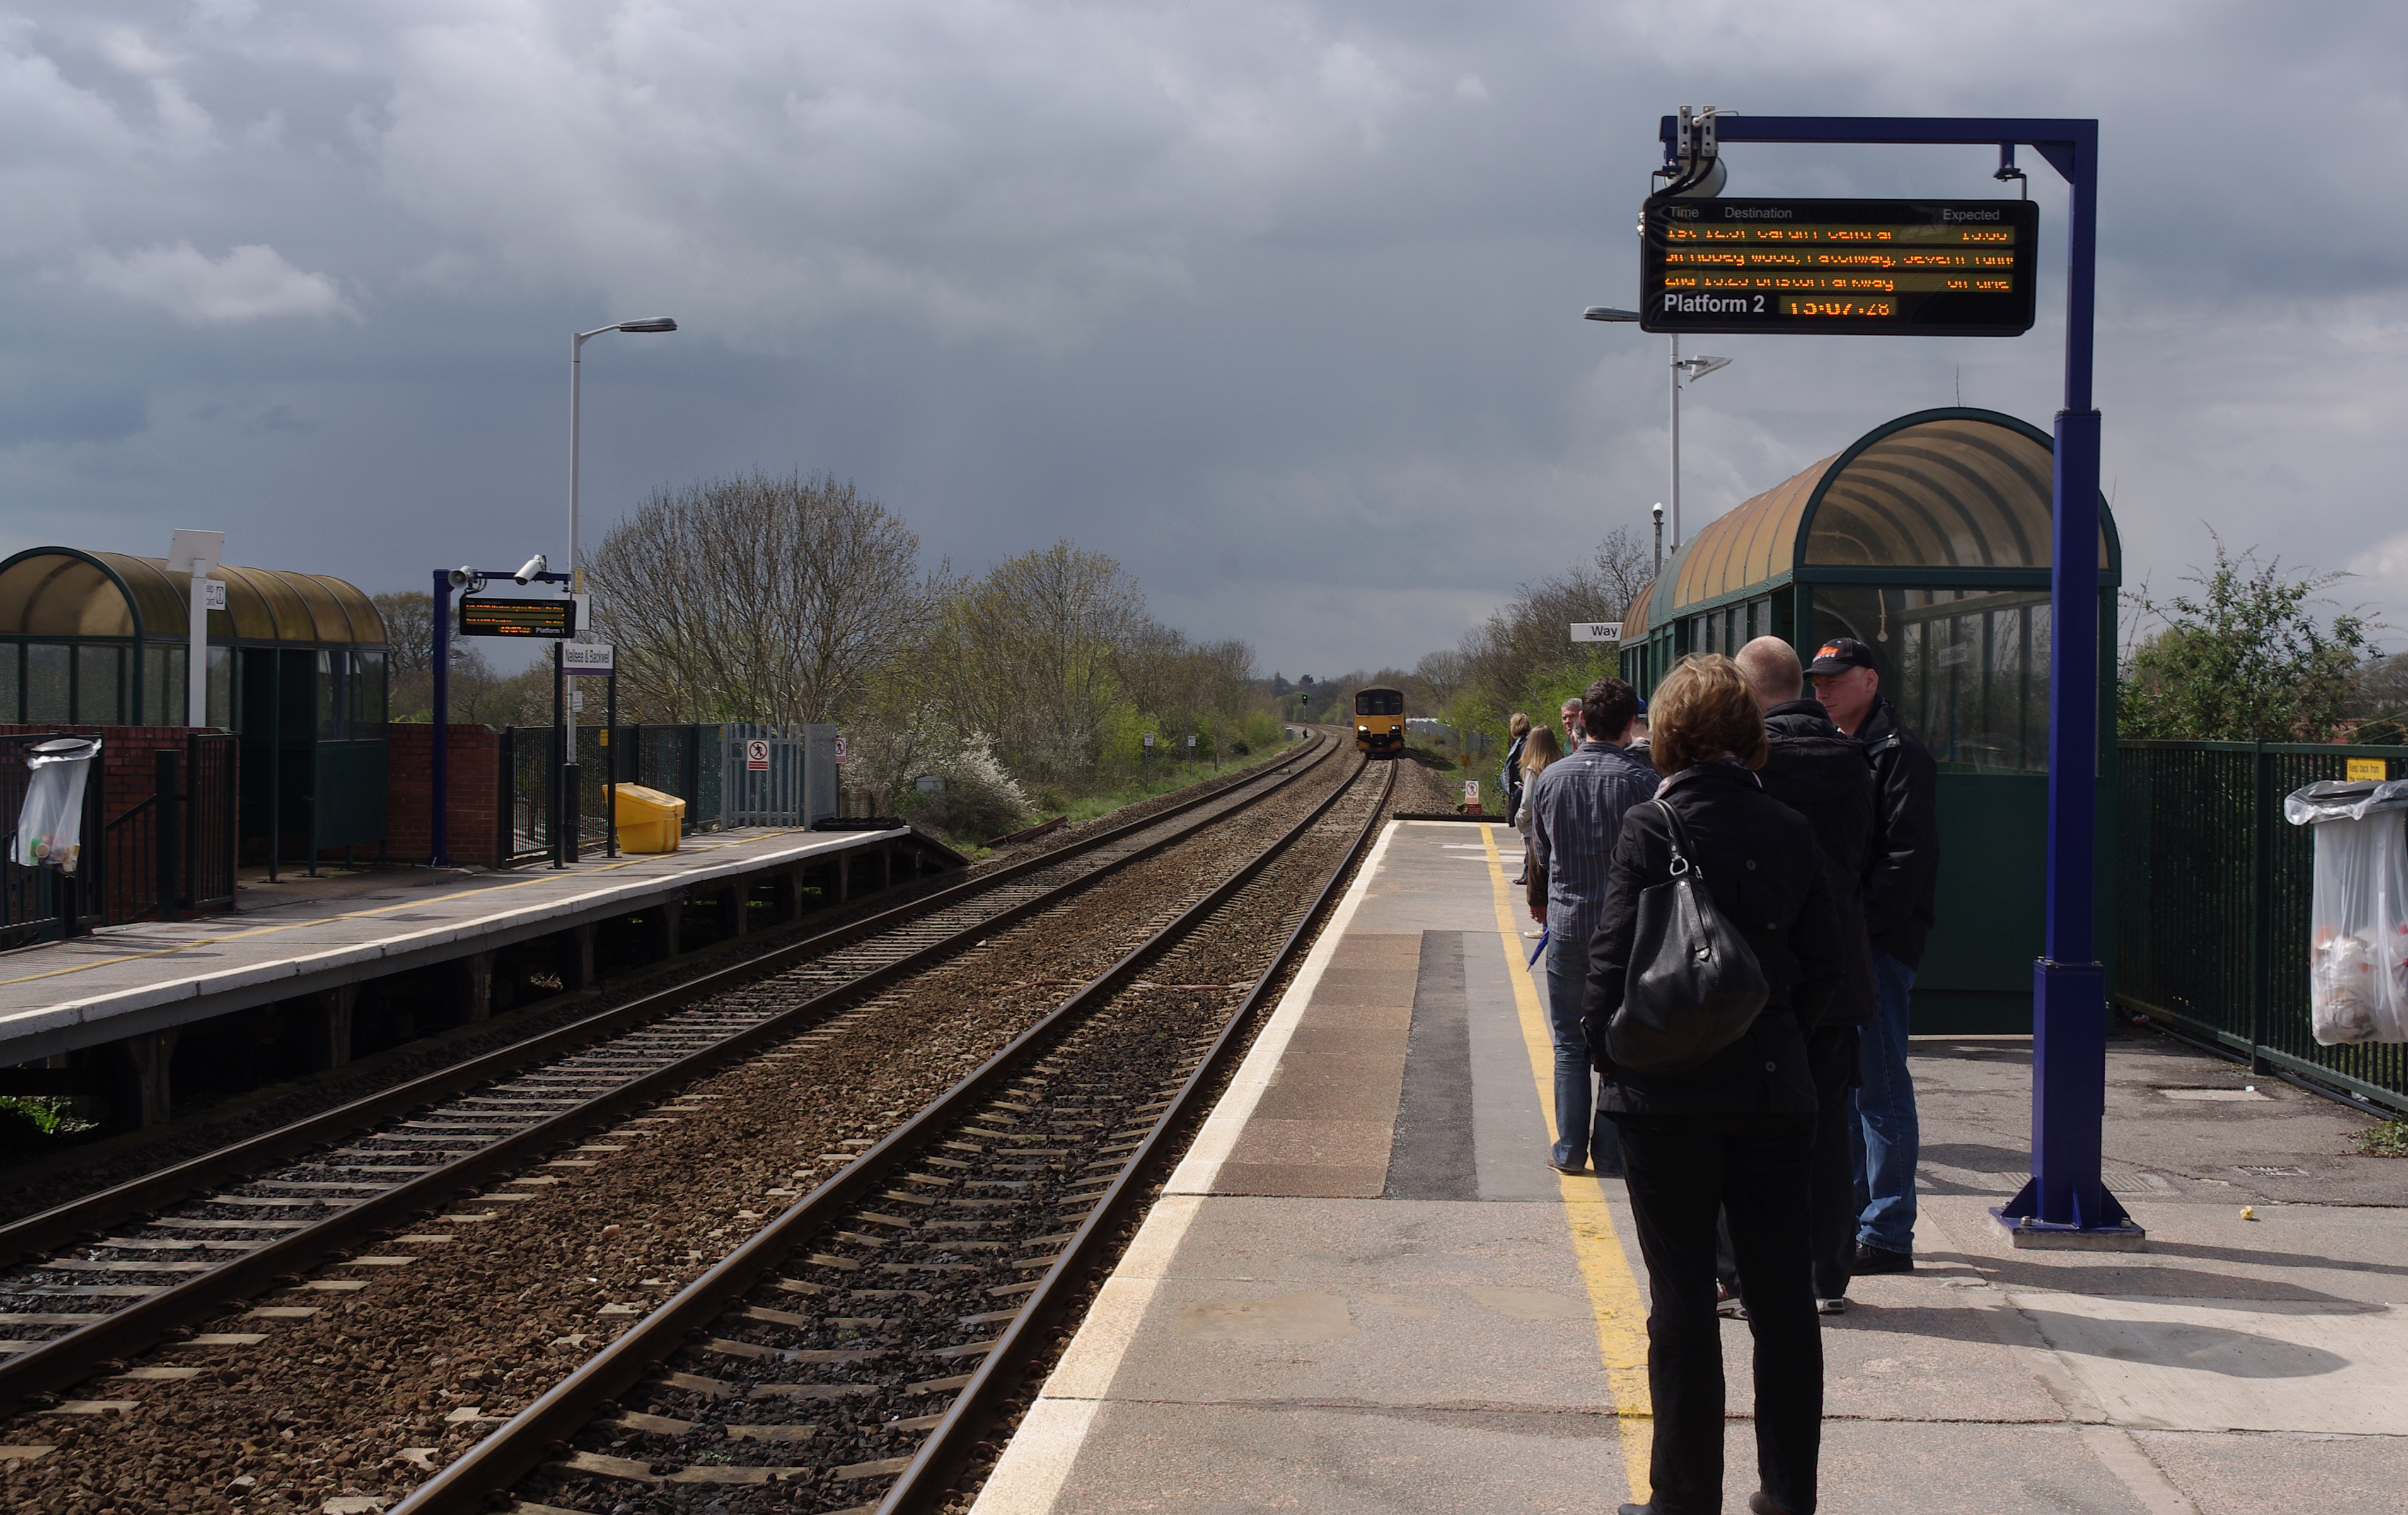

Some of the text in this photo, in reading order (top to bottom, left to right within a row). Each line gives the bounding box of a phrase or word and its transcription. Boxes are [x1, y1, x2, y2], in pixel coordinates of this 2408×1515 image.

[1669, 206, 2000, 223] Time Destination Expected
[1663, 293, 1748, 313] Platform
[1752, 294, 1766, 313] 2
[1592, 625, 1618, 638] Way
[565, 648, 610, 664] Nailsea & Backwell
